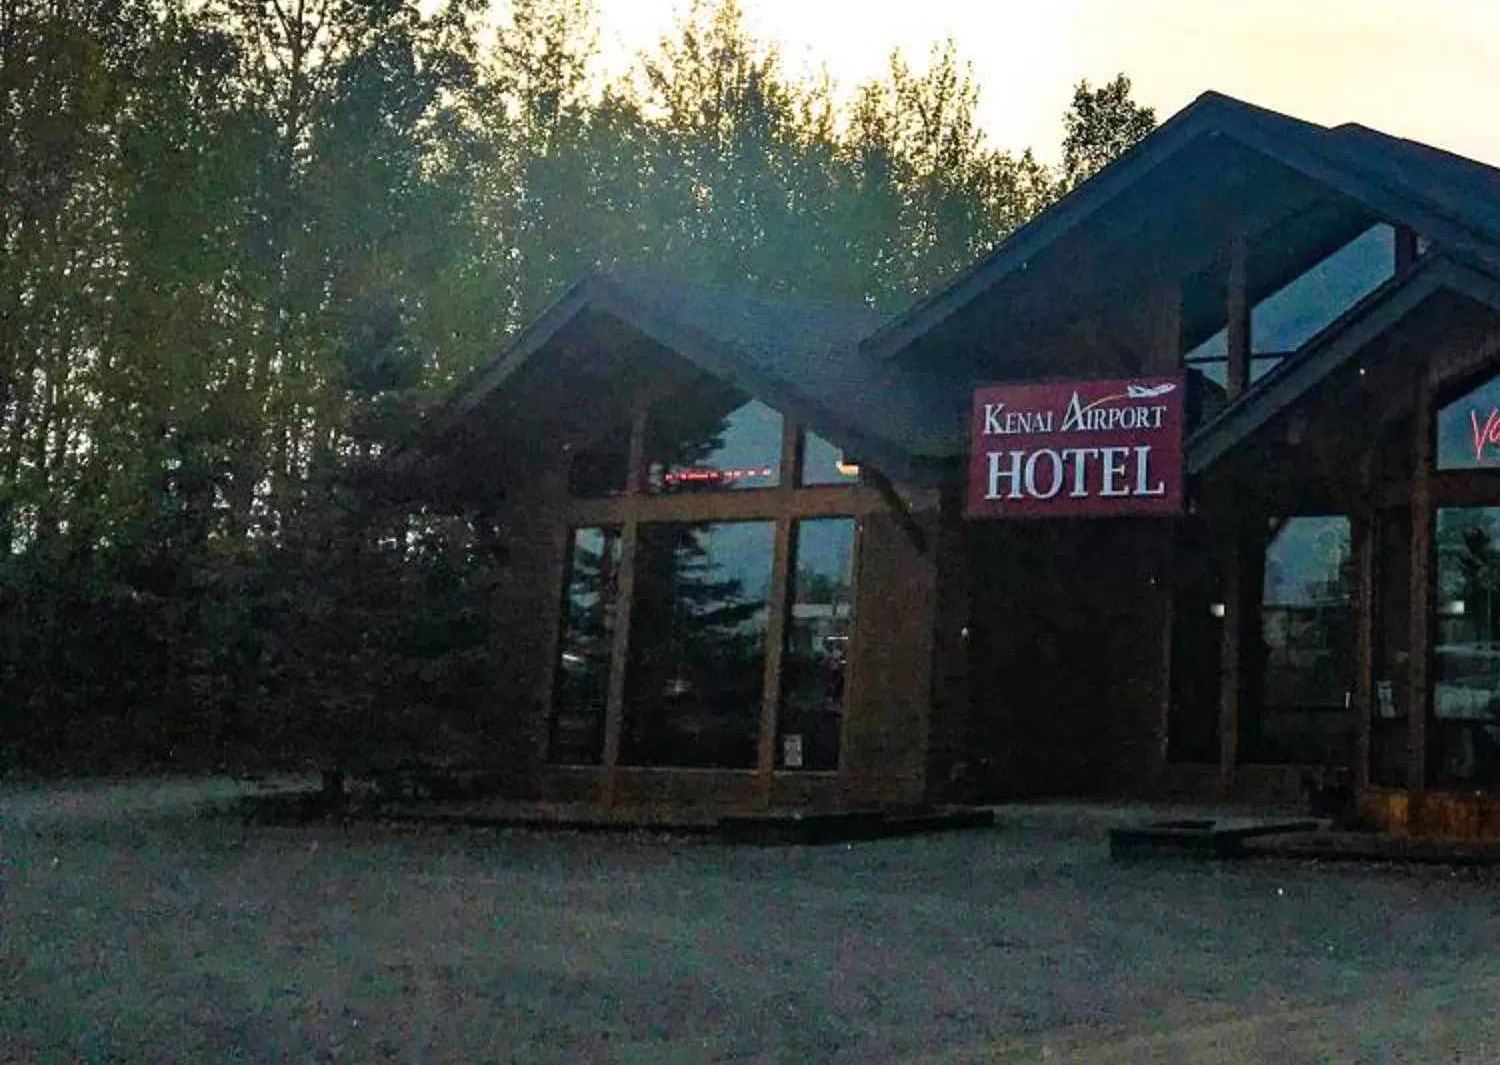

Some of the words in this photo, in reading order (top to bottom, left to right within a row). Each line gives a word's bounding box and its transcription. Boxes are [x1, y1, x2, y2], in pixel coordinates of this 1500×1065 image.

[984, 403, 1053, 435] KENAI
[1060, 390, 1167, 432] AIRPORT
[984, 446, 1165, 500] HOTEL
